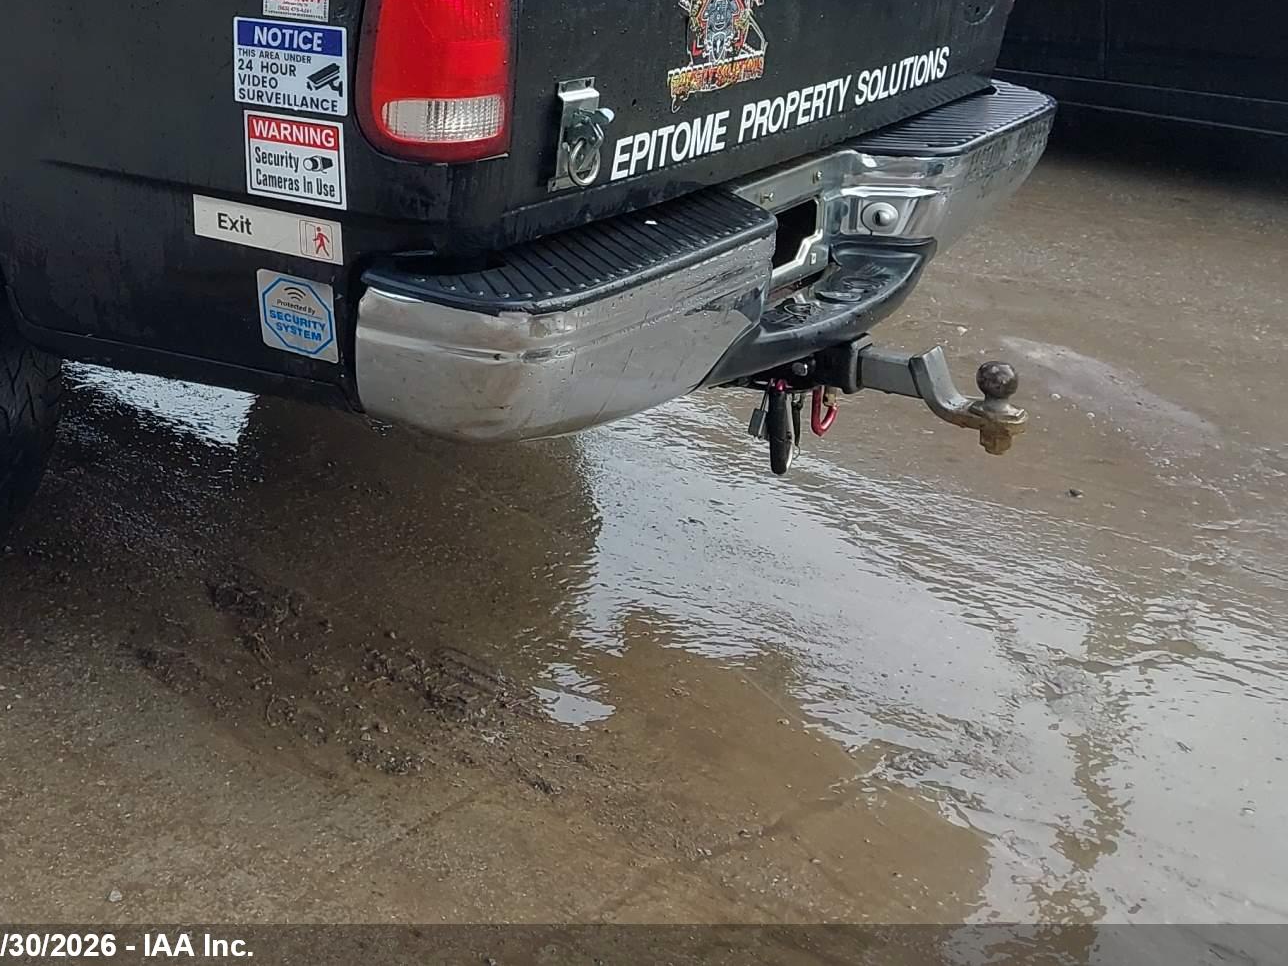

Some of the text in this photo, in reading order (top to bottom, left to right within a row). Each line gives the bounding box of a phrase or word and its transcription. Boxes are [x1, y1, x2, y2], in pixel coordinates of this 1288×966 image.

[253, 25, 324, 52] NOTICE
[237, 58, 297, 77] 24 HOUR
[238, 48, 312, 64] THIS AREA UNDER
[238, 73, 278, 90] VIDEO
[238, 88, 338, 113] SURVEILLANCE
[609, 46, 951, 181] EPITOME PROPERTY SOLUTIONS
[252, 118, 335, 148] WARNING
[254, 146, 300, 174] Security
[256, 168, 336, 198] Cameras In Use
[216, 212, 253, 235] Exit
[276, 298, 316, 316] Protected By
[269, 309, 326, 331] SECURITY
[276, 321, 322, 342] SYSTEM
